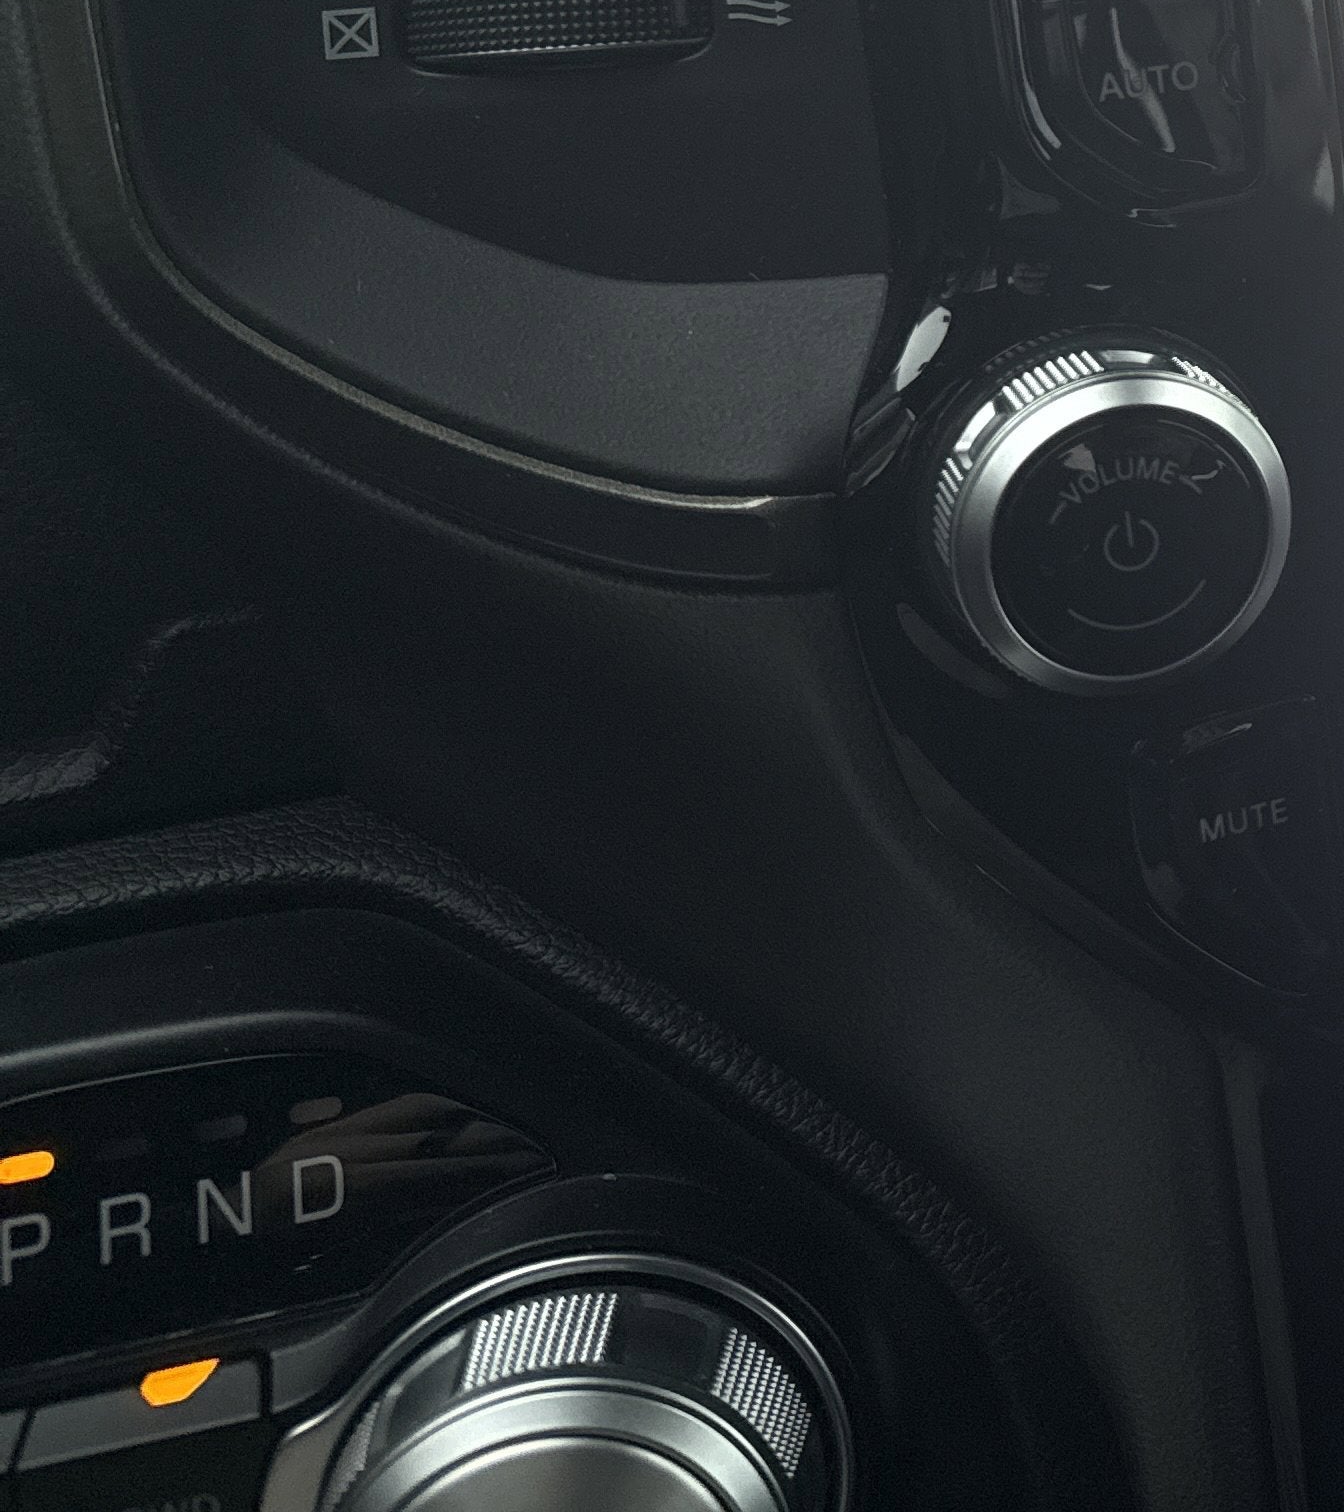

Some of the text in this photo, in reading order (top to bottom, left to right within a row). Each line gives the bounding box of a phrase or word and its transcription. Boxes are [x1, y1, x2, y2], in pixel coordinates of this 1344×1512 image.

[1100, 61, 1199, 102] AUTO
[1058, 456, 1181, 506] VOLUME
[1201, 798, 1289, 843] MUTE
[1, 1154, 345, 1286] P R N D
